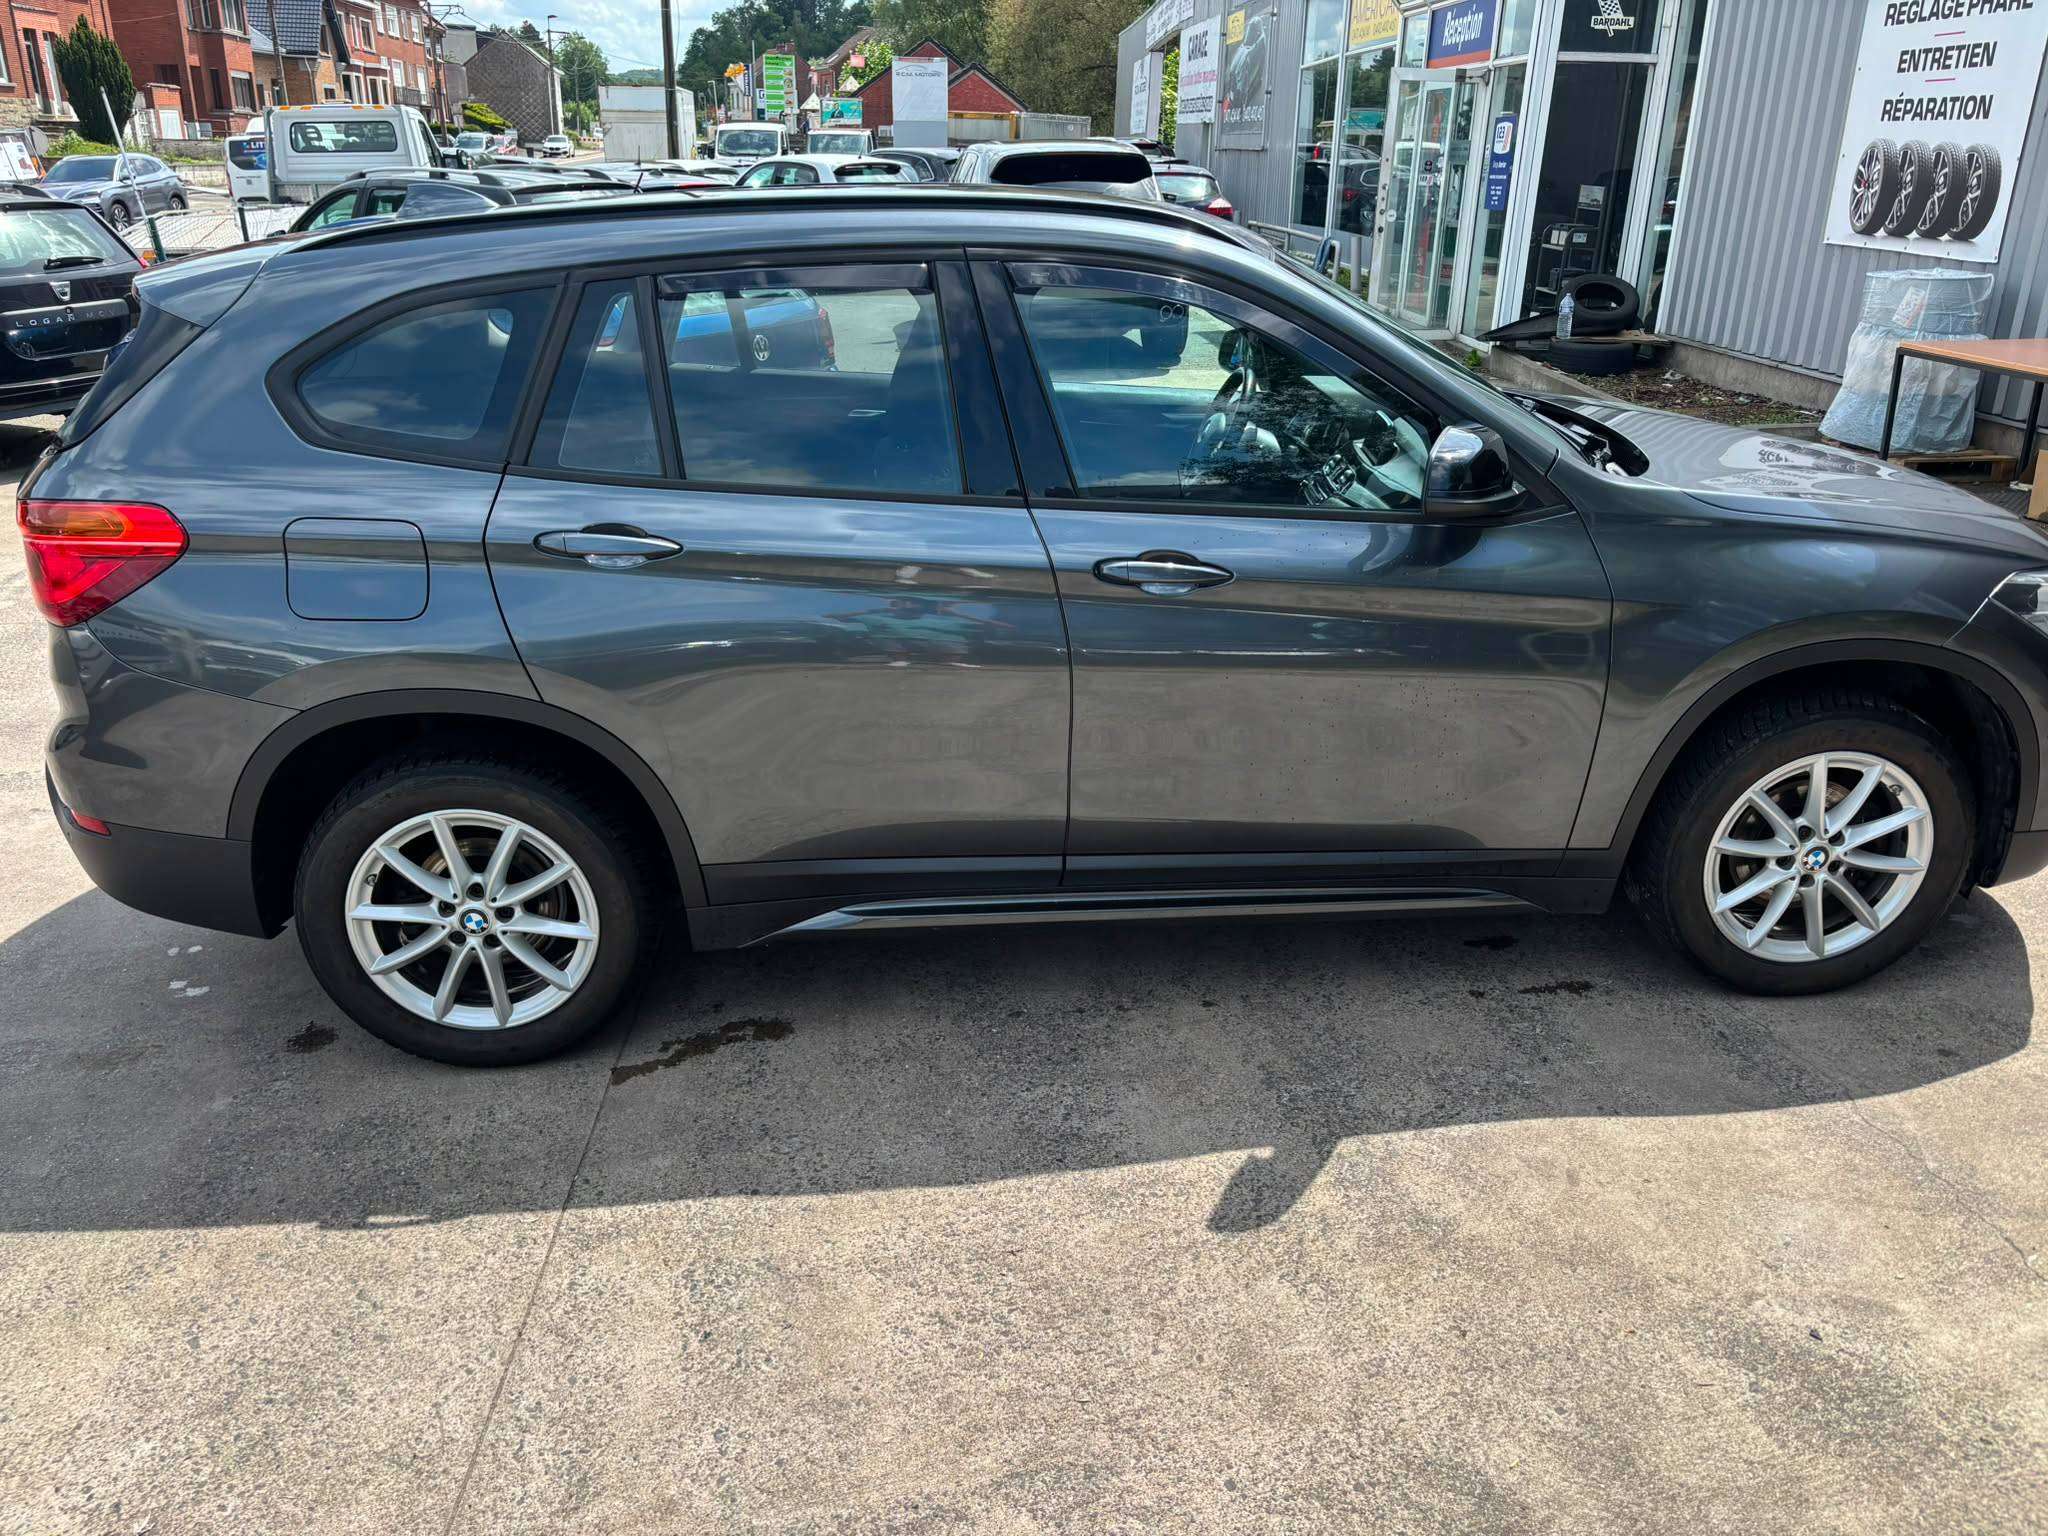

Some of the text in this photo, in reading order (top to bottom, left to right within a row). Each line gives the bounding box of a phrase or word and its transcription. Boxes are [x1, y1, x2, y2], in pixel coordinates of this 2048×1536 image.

[1442, 4, 1483, 52] Réception
[1593, 17, 1631, 27] BARDAHL
[1897, 41, 1998, 73] ENTRETIEN
[1880, 92, 1994, 121] RÉPARATION
[15, 313, 75, 327] LOGAN
